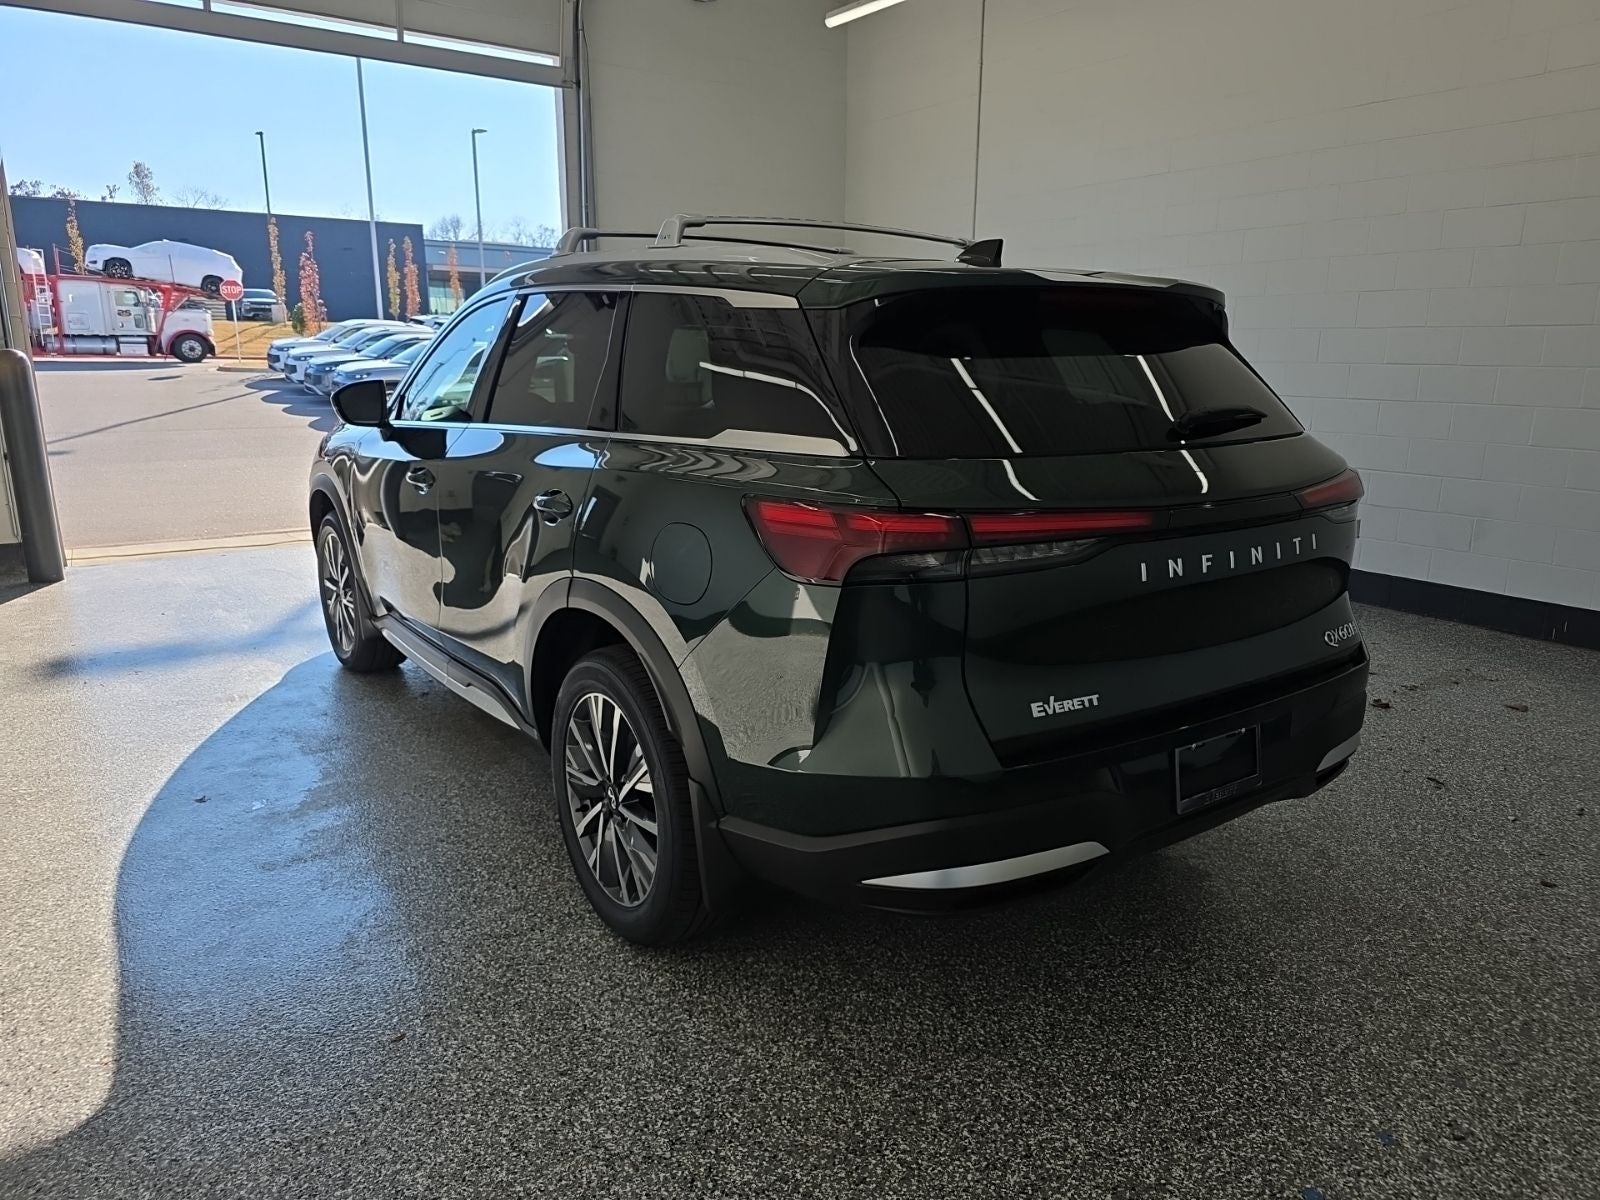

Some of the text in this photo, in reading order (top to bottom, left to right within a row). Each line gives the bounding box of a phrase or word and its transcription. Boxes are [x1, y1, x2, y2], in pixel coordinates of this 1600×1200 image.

[222, 285, 242, 294] STOP
[1140, 533, 1317, 582] INFINITI
[1030, 693, 1100, 718] EVERETT
